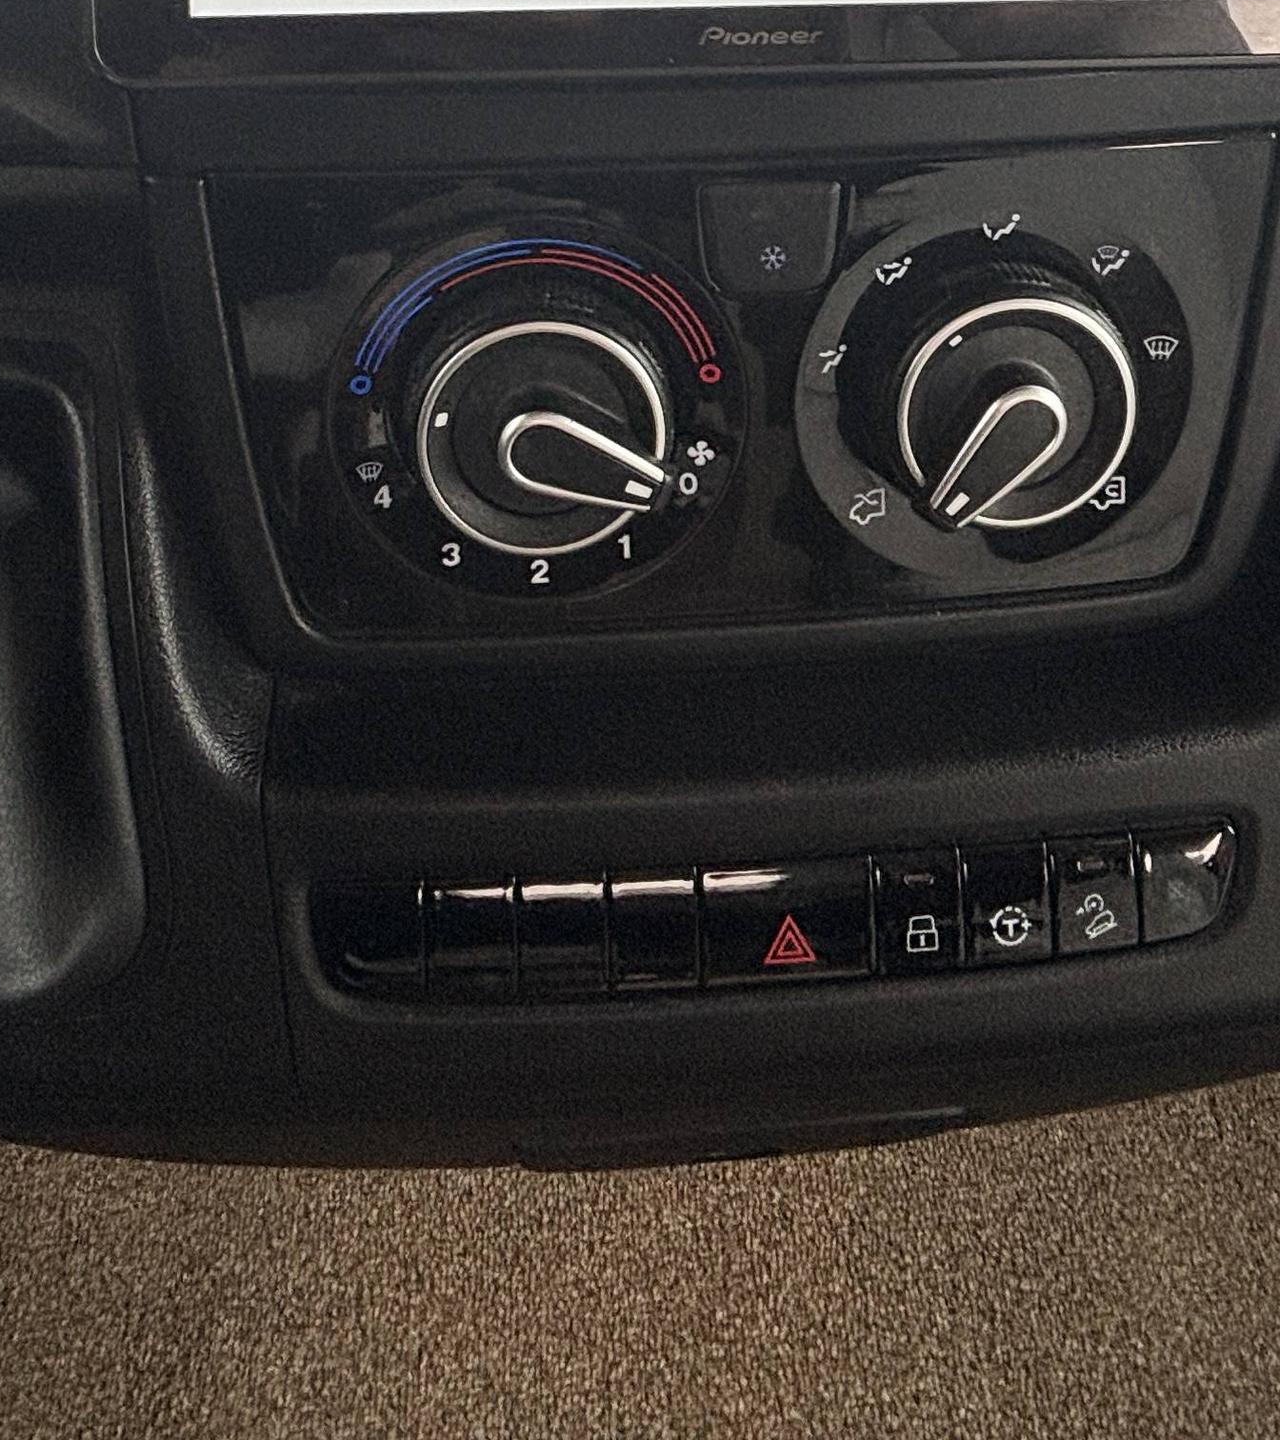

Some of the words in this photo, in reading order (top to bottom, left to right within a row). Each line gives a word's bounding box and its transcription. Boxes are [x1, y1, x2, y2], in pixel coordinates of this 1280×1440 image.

[698, 26, 824, 46] Pioneer
[678, 472, 699, 495] 0
[373, 484, 393, 509] 4
[440, 542, 462, 567] 3
[617, 534, 633, 559] 1
[529, 560, 551, 584] 2
